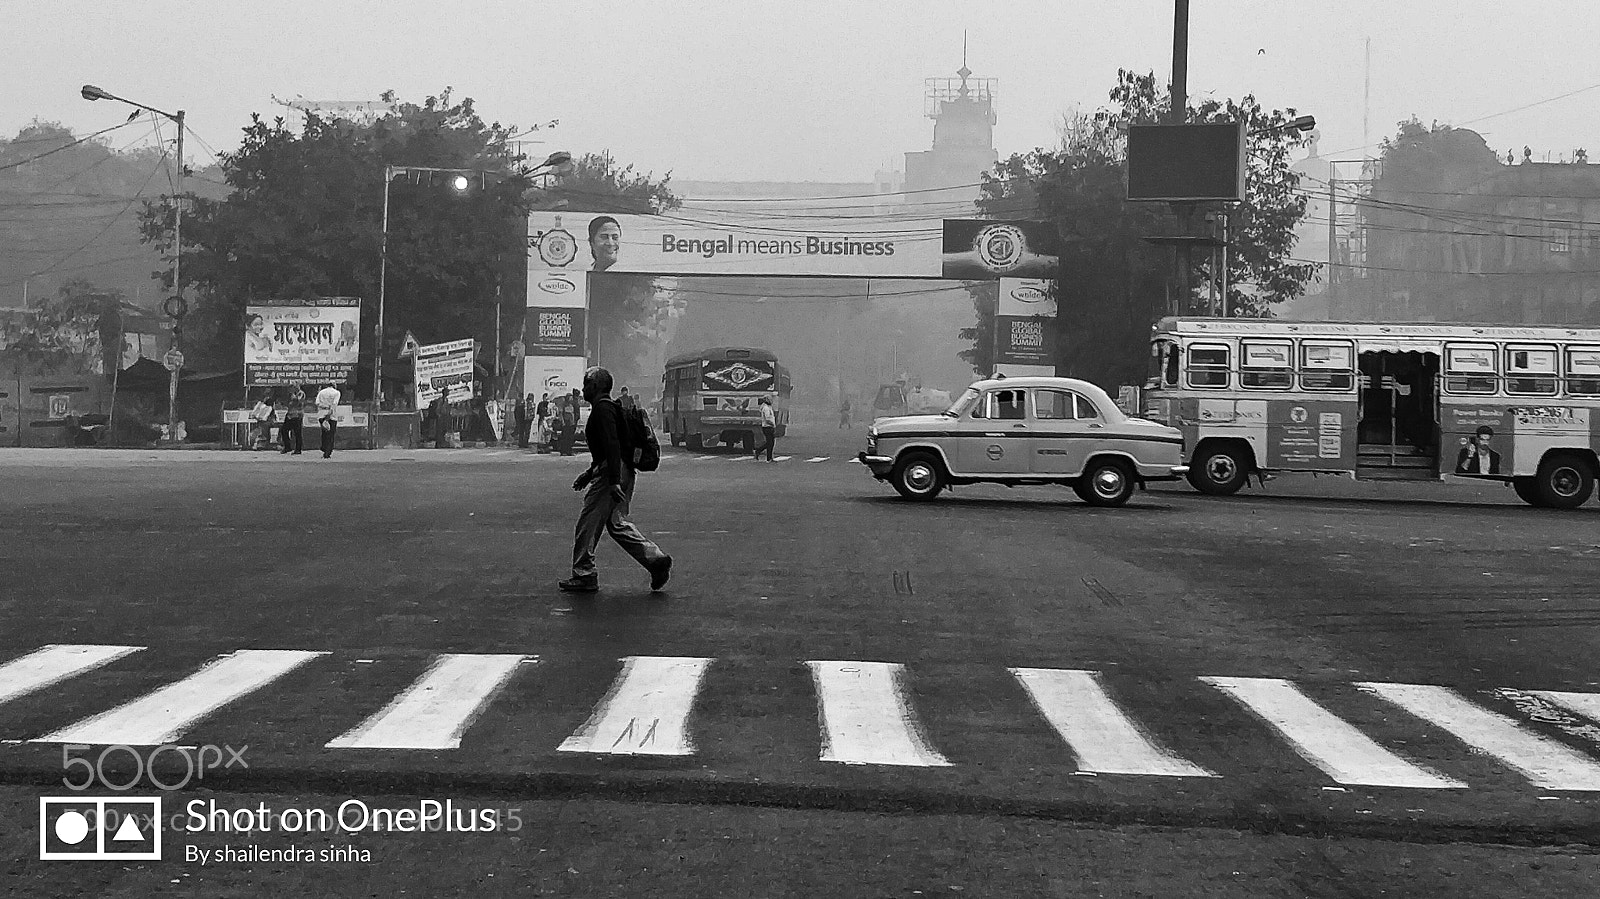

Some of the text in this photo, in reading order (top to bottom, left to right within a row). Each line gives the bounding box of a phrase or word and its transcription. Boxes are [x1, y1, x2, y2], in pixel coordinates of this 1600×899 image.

[662, 234, 895, 258] Bengal means Business
[539, 312, 572, 320] BENGAL
[274, 322, 334, 345] সম্মেলন
